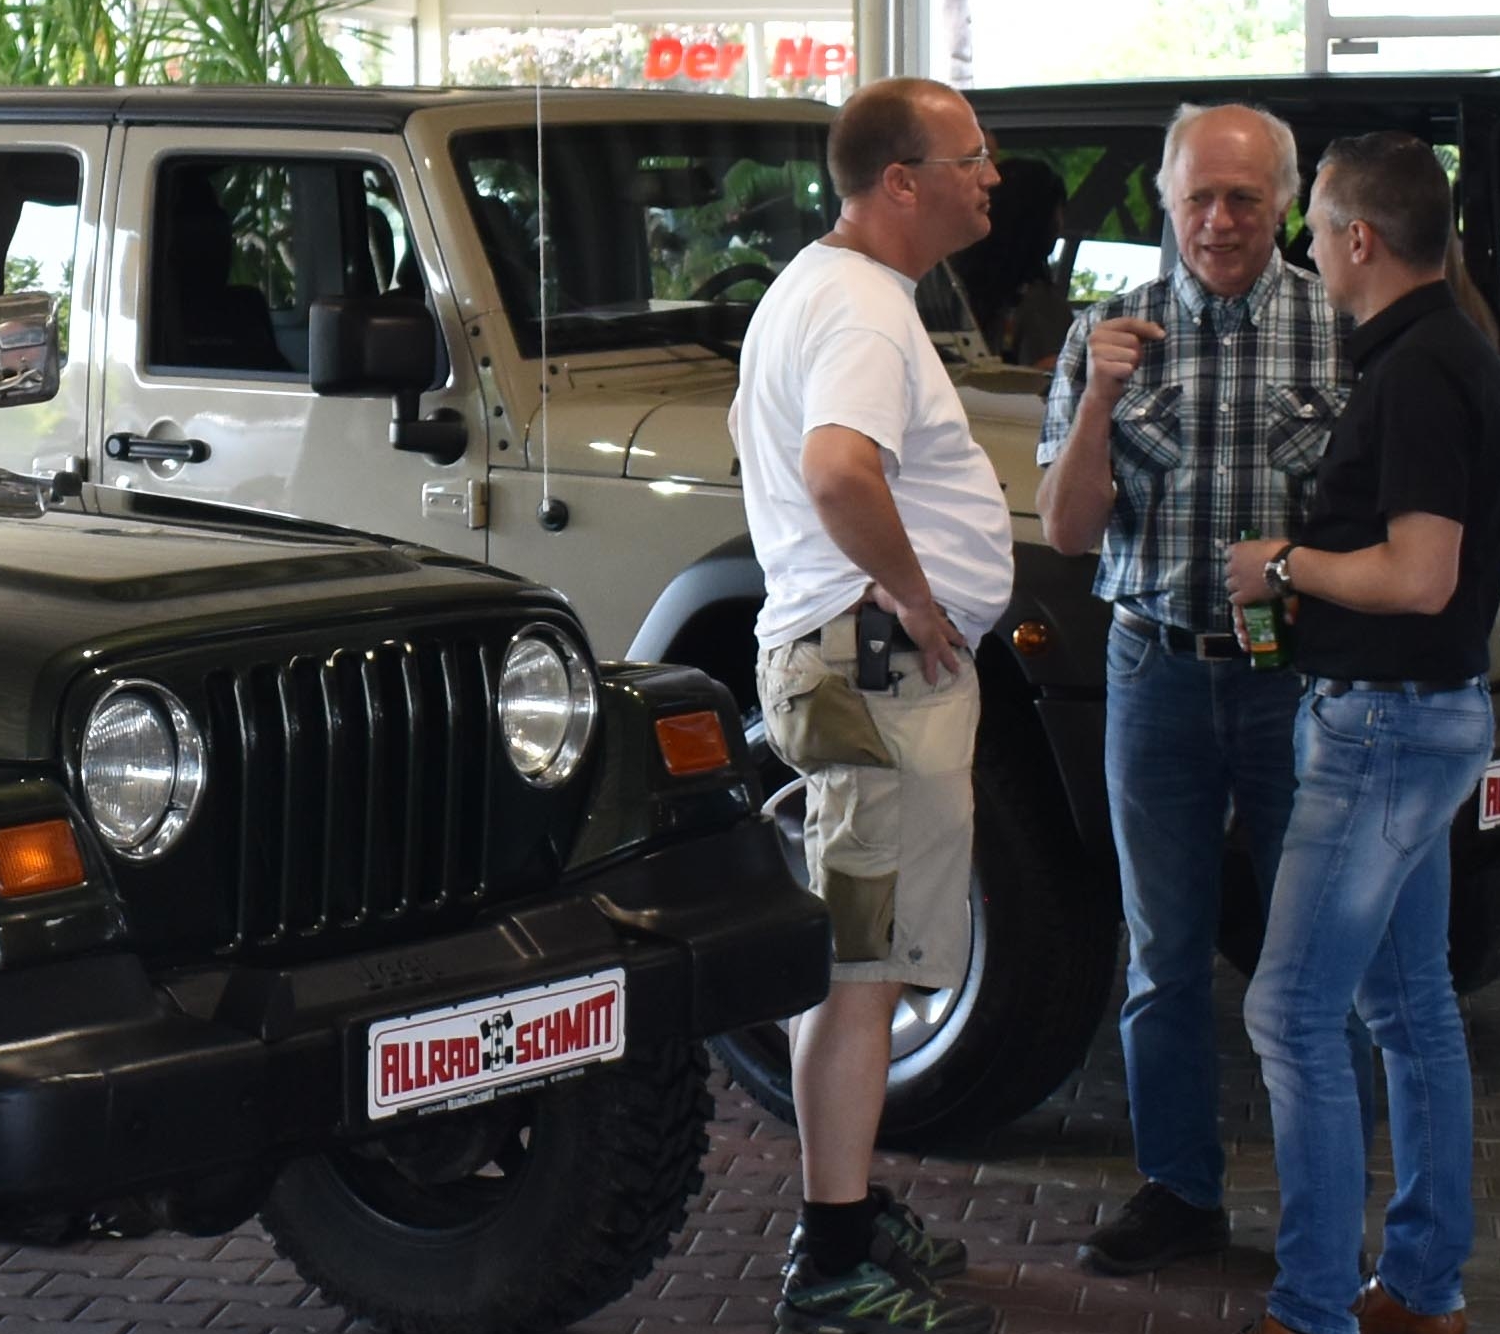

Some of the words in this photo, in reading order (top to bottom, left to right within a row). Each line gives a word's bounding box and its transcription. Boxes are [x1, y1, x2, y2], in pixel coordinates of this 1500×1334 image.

[643, 37, 746, 81] Der
[380, 1035, 480, 1097] ALLRAD
[515, 990, 616, 1065] SCHMITT
